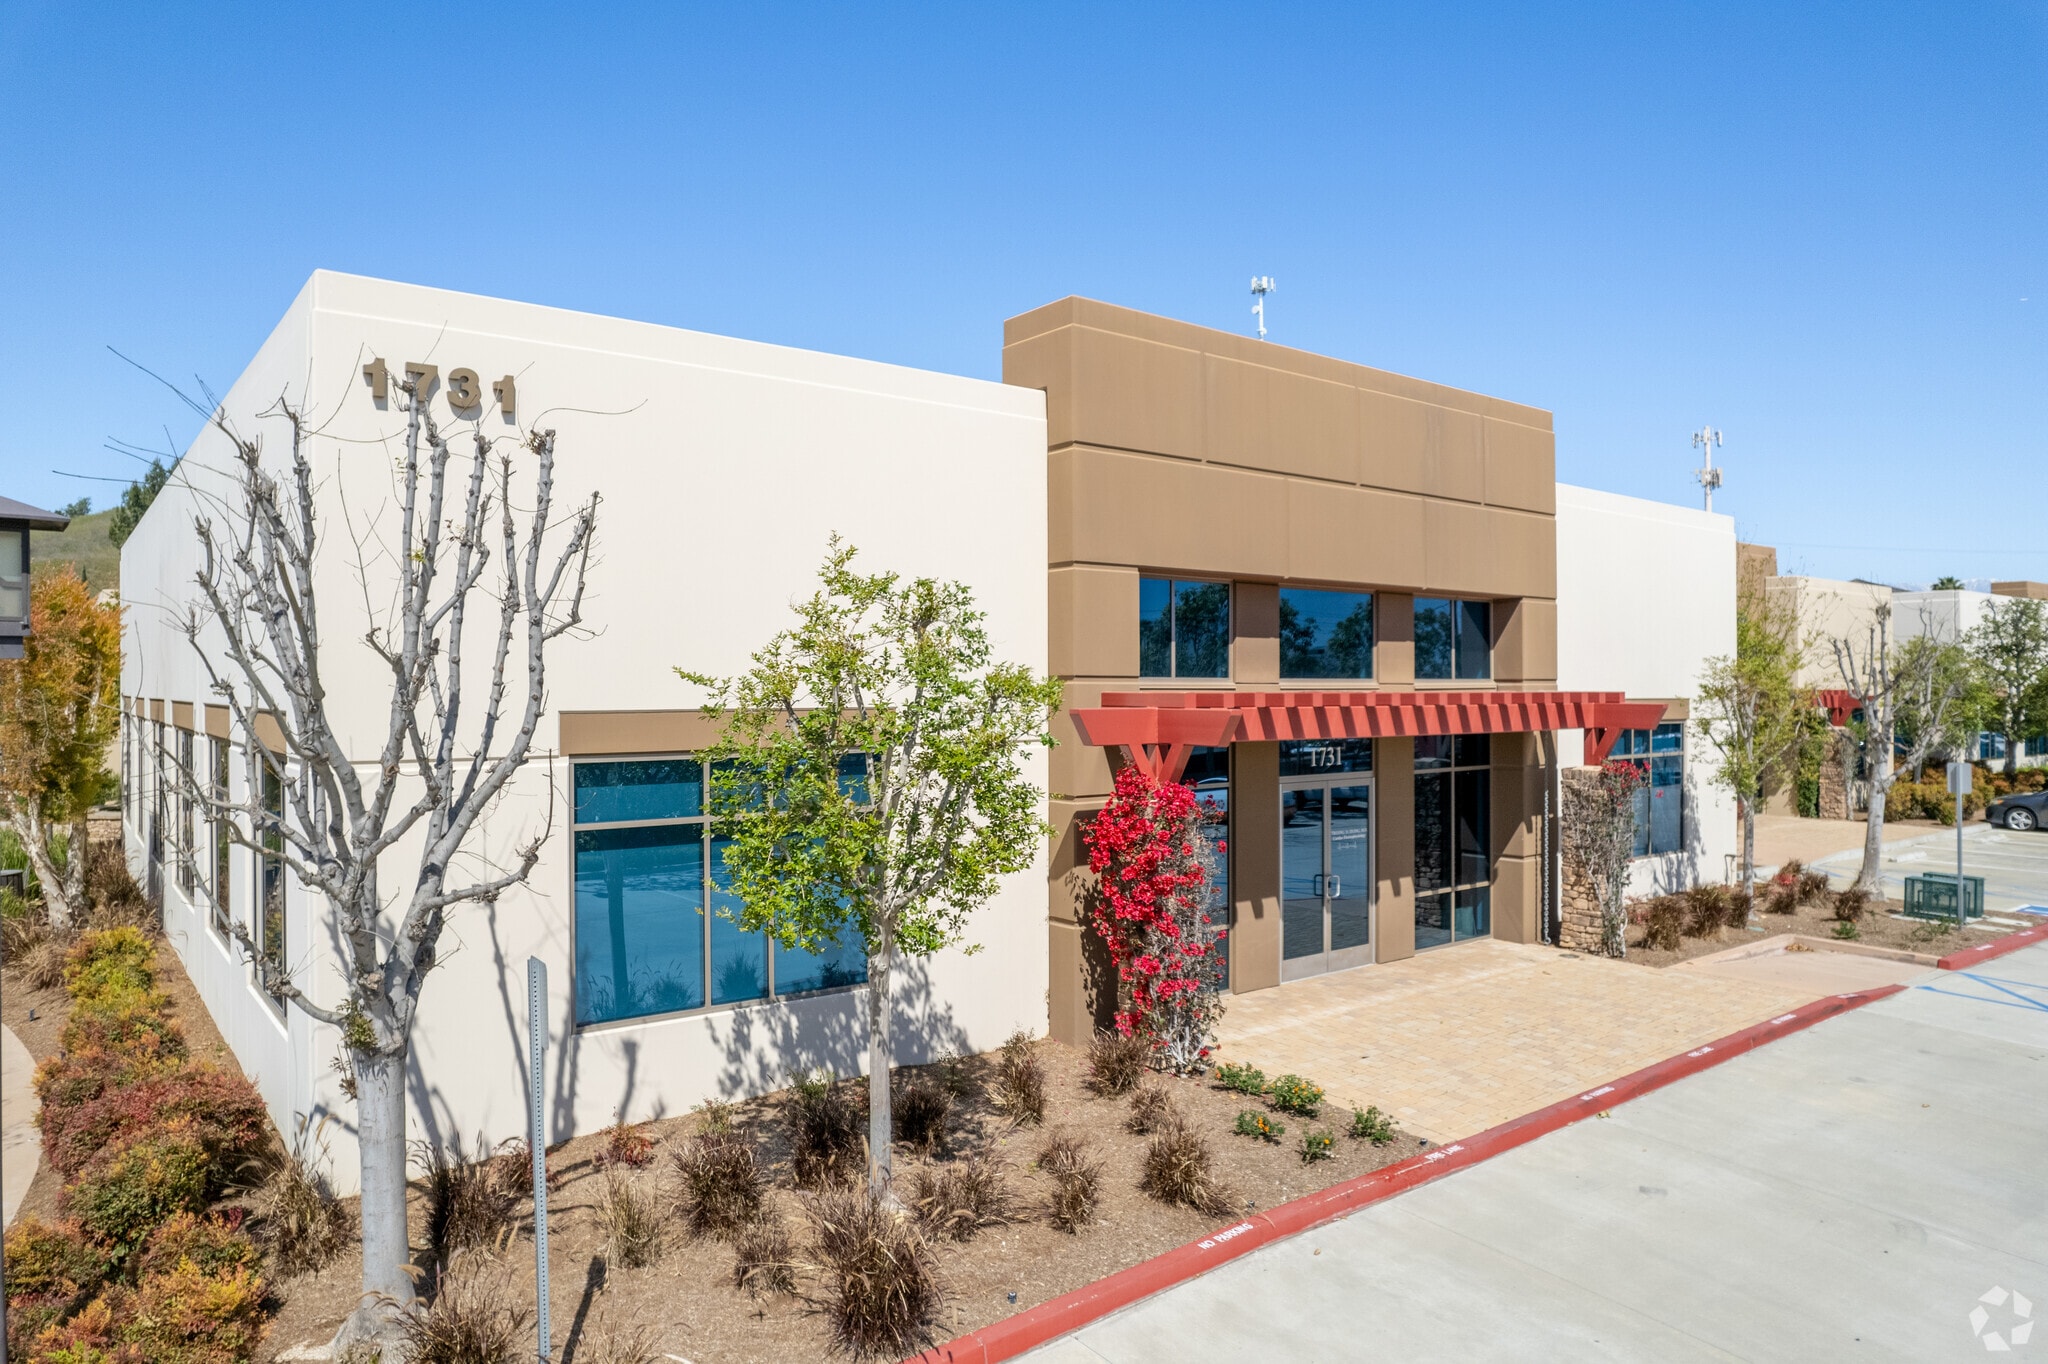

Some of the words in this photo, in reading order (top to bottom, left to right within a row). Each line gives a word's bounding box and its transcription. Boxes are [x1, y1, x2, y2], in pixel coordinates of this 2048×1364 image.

[363, 358, 516, 413] 1731
[1310, 746, 1342, 767] 1731
[1196, 1239, 1216, 1250] NO
[1212, 1223, 1254, 1243] PARKING
